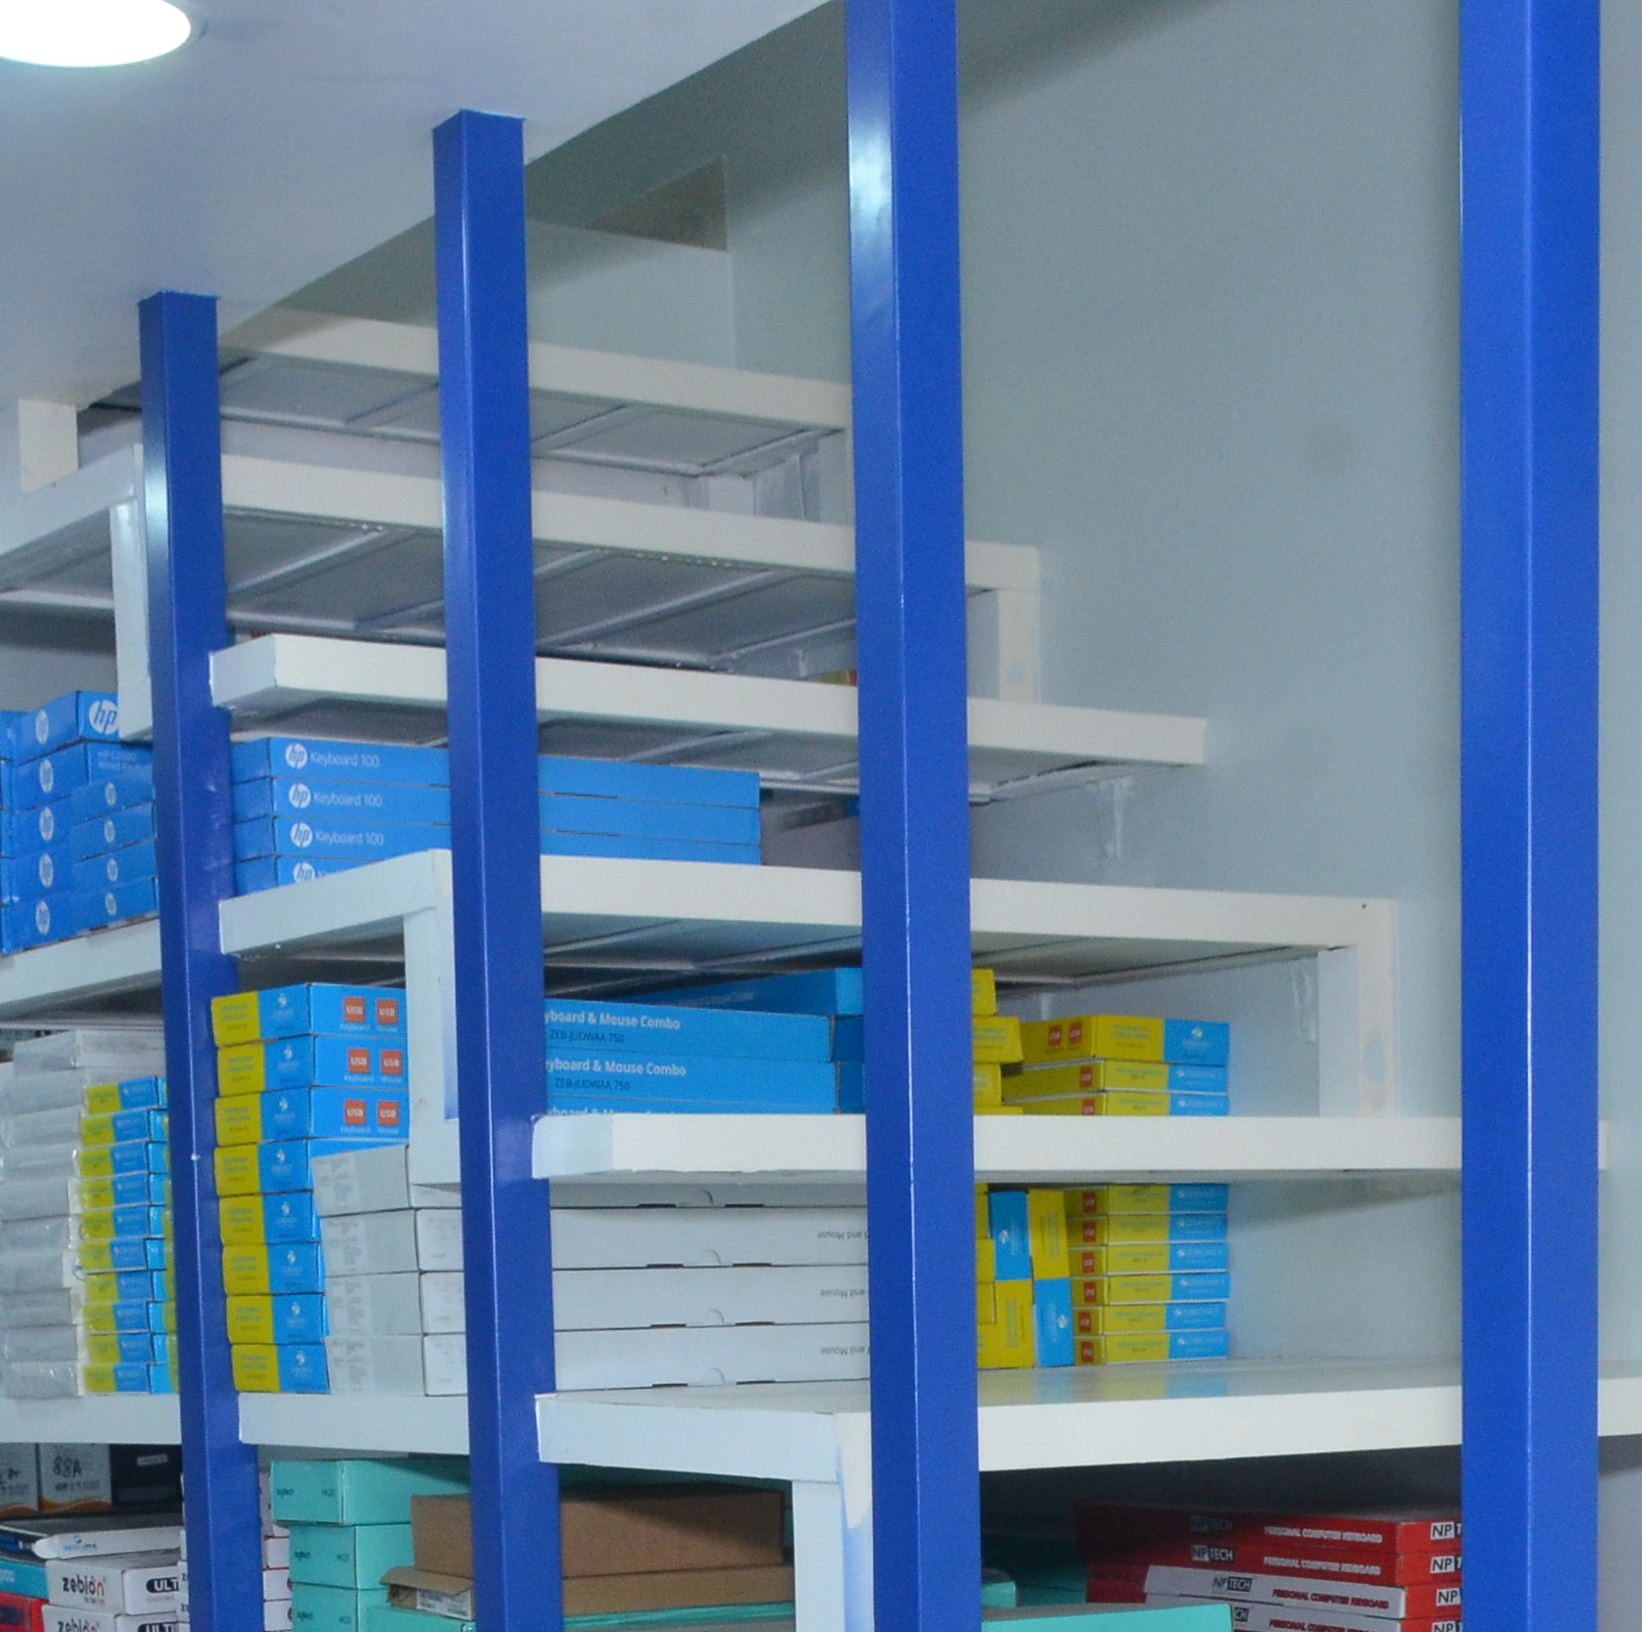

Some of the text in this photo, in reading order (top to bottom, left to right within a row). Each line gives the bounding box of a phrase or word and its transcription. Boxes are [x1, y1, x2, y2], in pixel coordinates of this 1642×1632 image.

[286, 743, 379, 768] hp Keyboard 100
[290, 784, 382, 808] hp Keyboard 100
[291, 822, 383, 848] hp Keyboard 100
[347, 1006, 395, 1016] USB USB
[589, 1011, 596, 1024] &
[600, 1014, 637, 1026] Mouse
[641, 1016, 680, 1029] Combo
[351, 1058, 399, 1066] USB USB
[593, 1060, 601, 1071] &
[606, 1061, 643, 1073] Mouse
[647, 1063, 686, 1076] Combo
[1272, 1589, 1389, 1609] PERSONAL COMPUTER KEYBOARD
